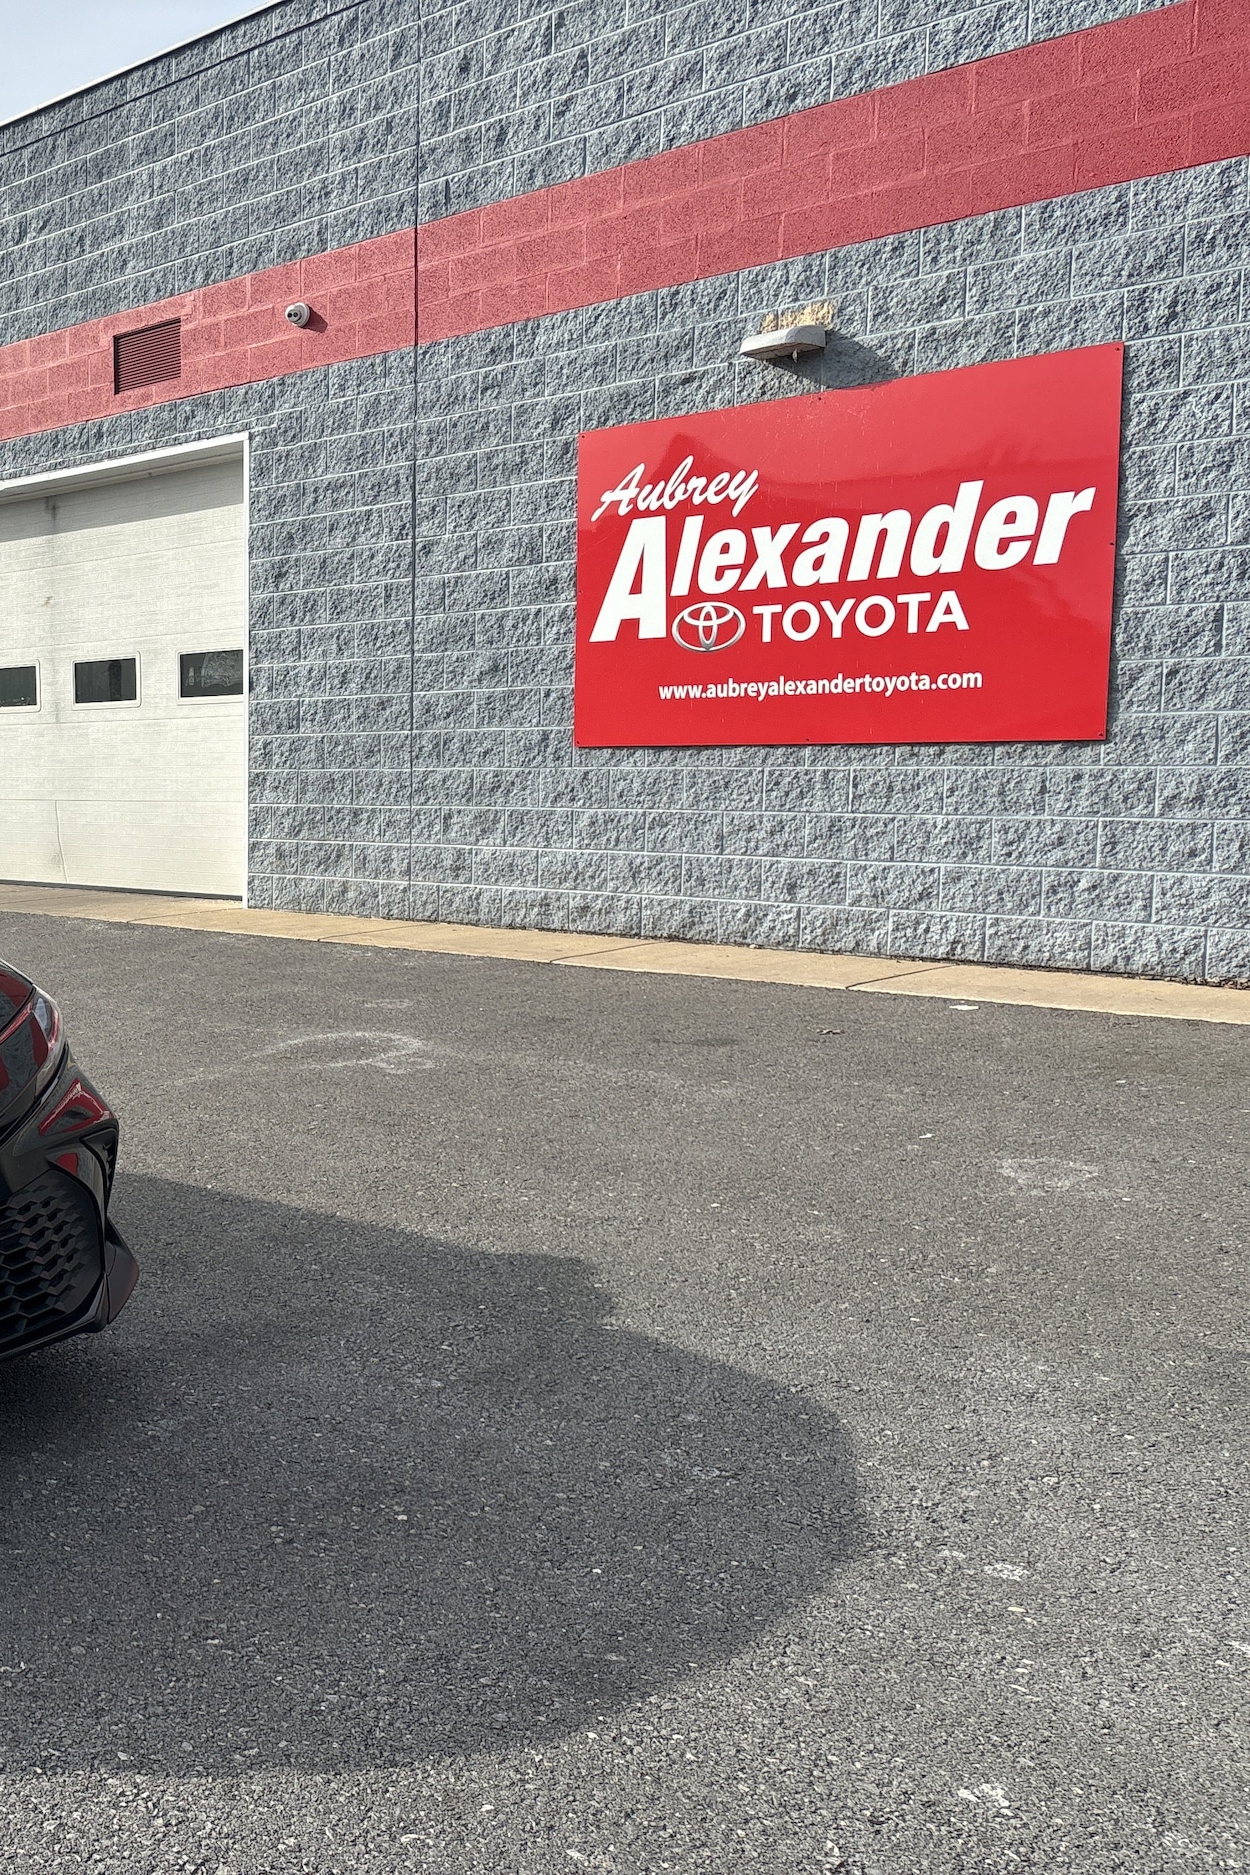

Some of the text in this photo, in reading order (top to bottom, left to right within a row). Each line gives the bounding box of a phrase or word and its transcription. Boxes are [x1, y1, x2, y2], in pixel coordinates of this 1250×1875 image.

[590, 456, 759, 522] Aubrey
[589, 480, 1097, 643] Alexander
[752, 590, 970, 643] TOYOTA
[658, 671, 983, 702] www.aubreyalexandertoyota.com
